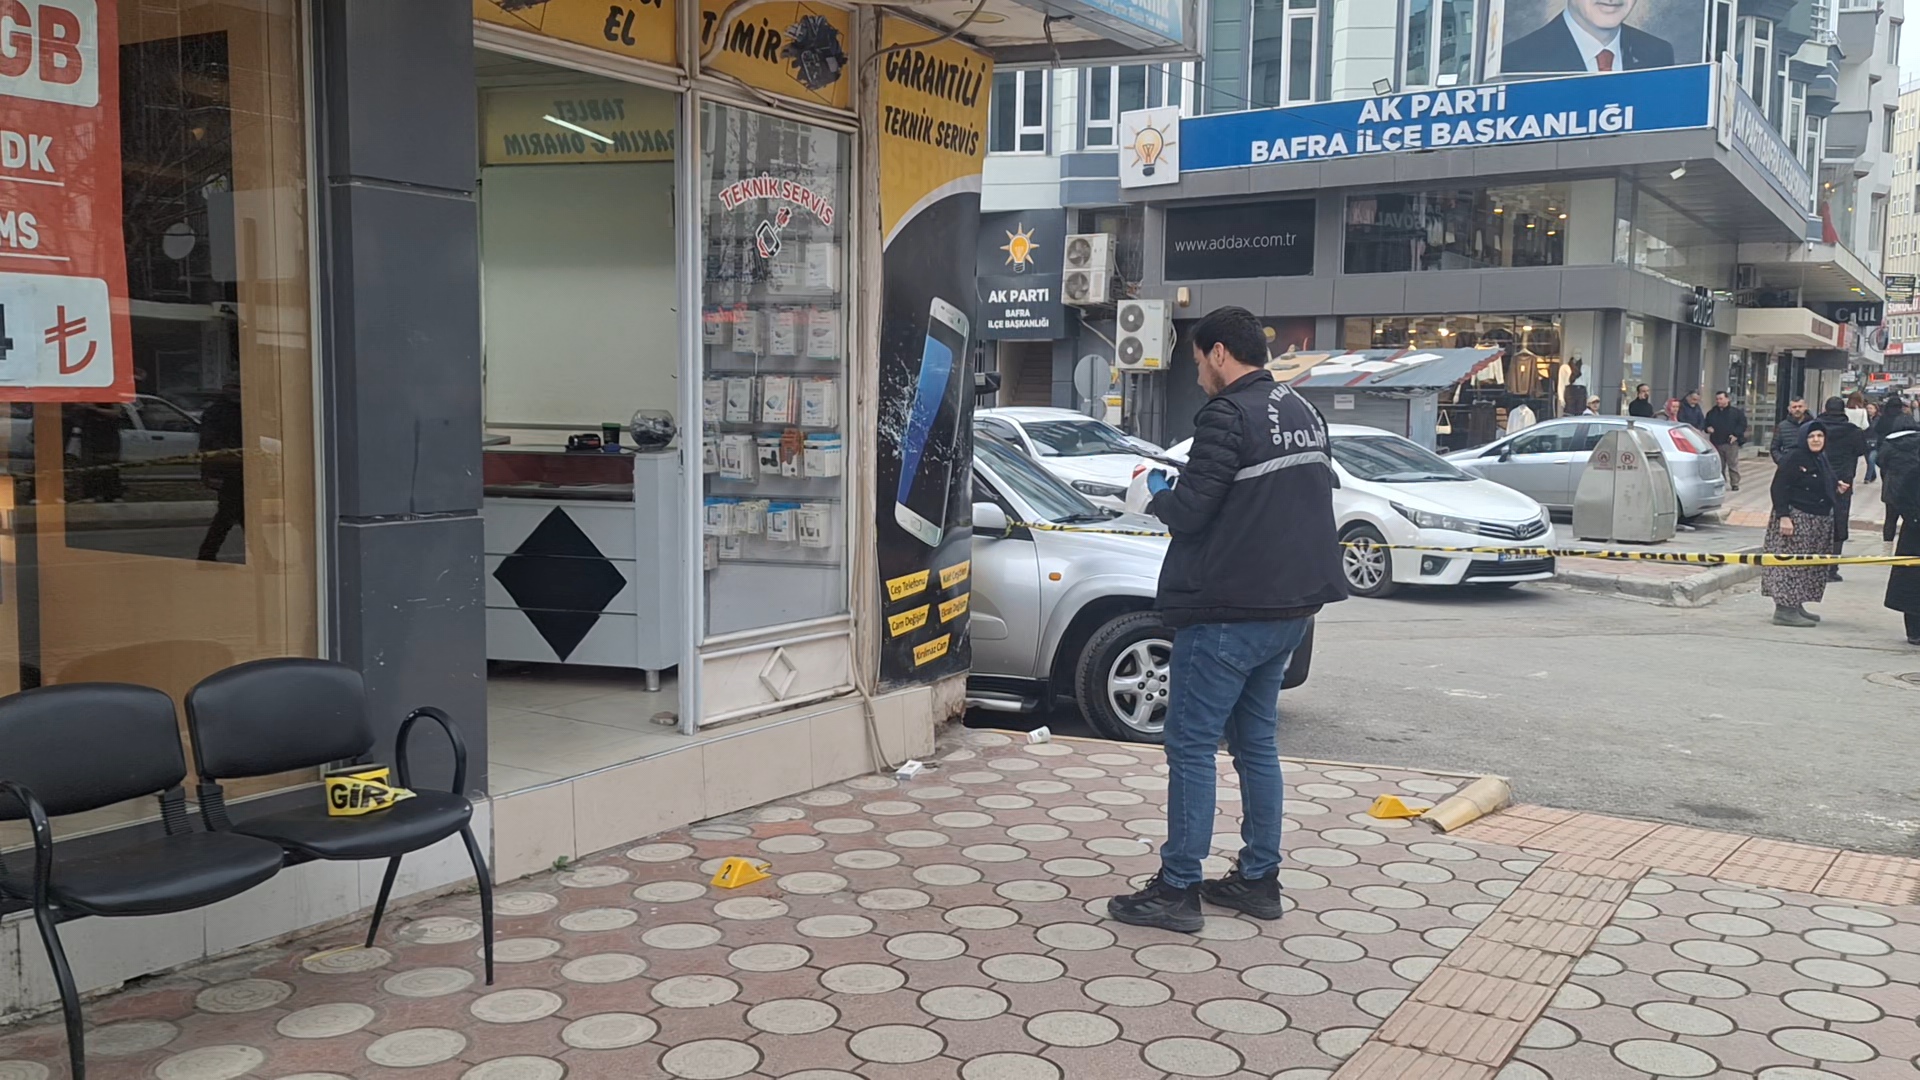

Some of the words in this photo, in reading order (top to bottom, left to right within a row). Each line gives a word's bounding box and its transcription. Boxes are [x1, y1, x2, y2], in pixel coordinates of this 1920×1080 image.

[0, 0, 83, 85] GB
[603, 6, 636, 46] EL
[886, 43, 986, 108] GARANTİLİ
[1357, 97, 1403, 124] AK
[1411, 85, 1506, 118] PARTİ
[885, 105, 934, 145] TEKNİK
[935, 120, 979, 156] SERVİS
[1251, 133, 1349, 163] BAFRA
[1356, 125, 1422, 151] İLÇE
[1431, 103, 1634, 146] BAŞKANLIĞI
[2, 131, 55, 173] DK
[719, 171, 780, 211] TEKNİK
[782, 180, 834, 226] SERVİS
[1174, 232, 1297, 252] www.addax.com.tr
[988, 289, 1007, 303] AK
[1005, 309, 1031, 317] BAFRA
[721, 864, 732, 880] 2
